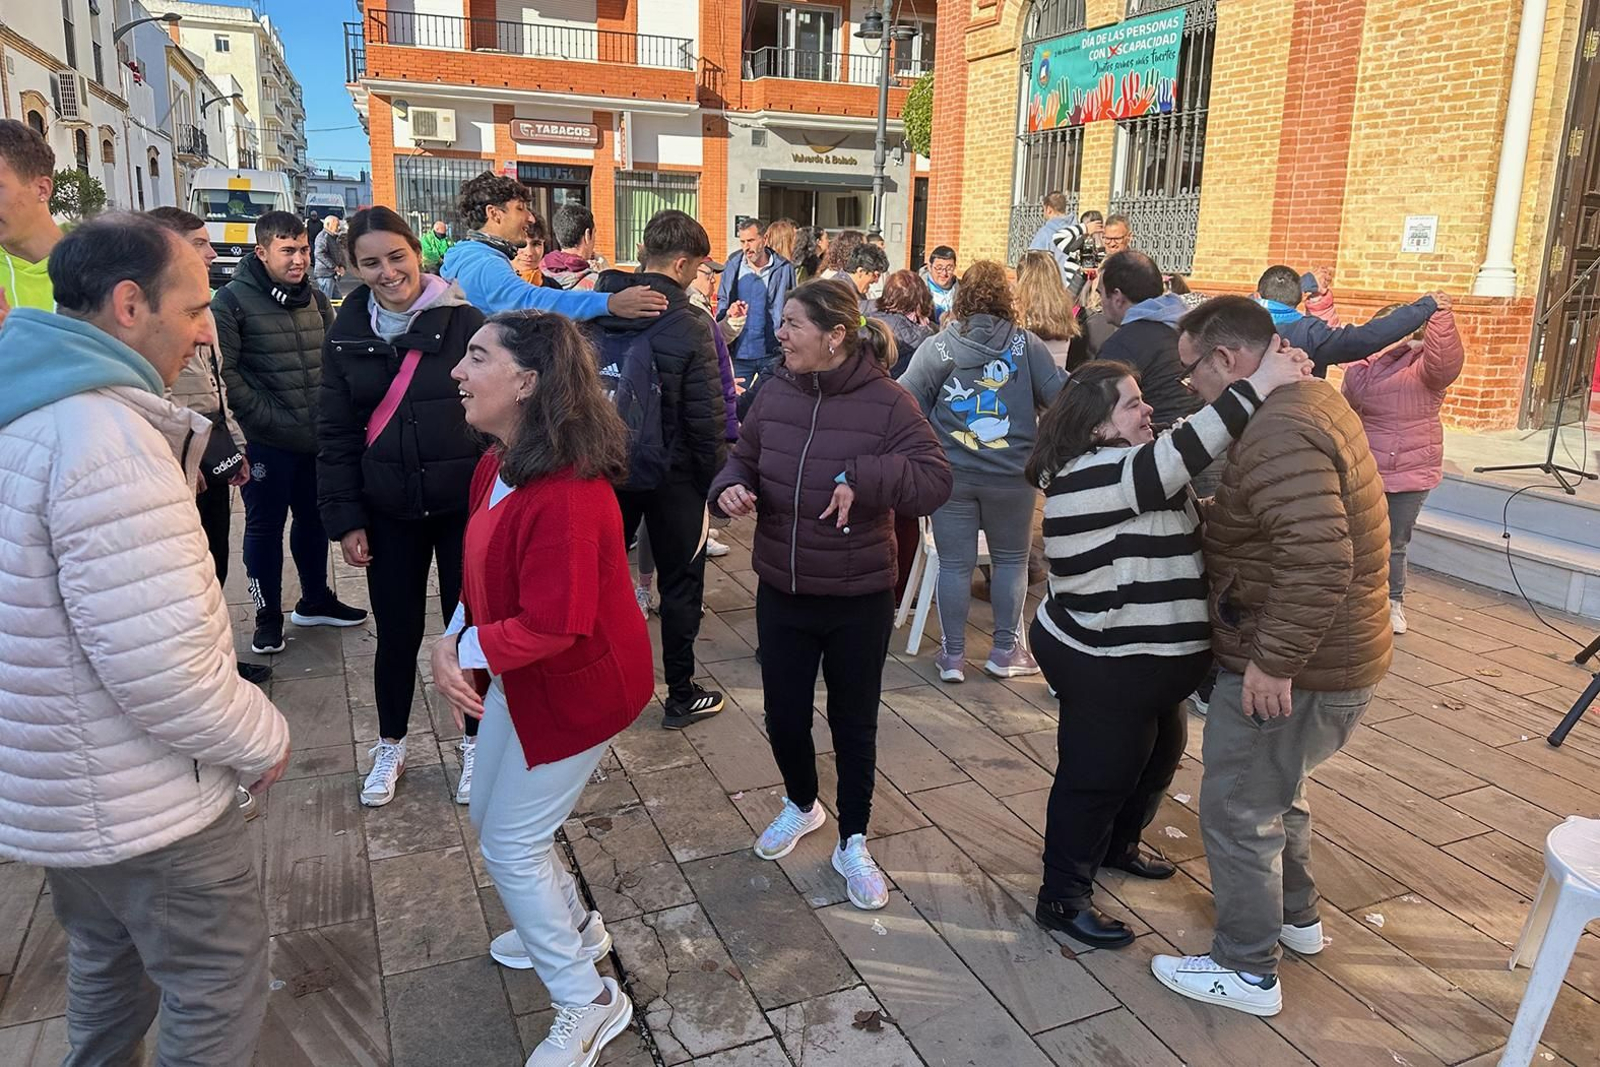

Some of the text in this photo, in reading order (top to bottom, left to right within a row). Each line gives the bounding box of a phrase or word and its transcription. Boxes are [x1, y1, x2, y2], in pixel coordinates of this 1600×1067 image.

[1081, 16, 1179, 49] DÍA DE LAS PERSONAS
[1089, 47, 1106, 61] CON
[1150, 48, 1176, 65] fuertes
[535, 124, 591, 137] TABACOS
[212, 453, 243, 475] adidas
